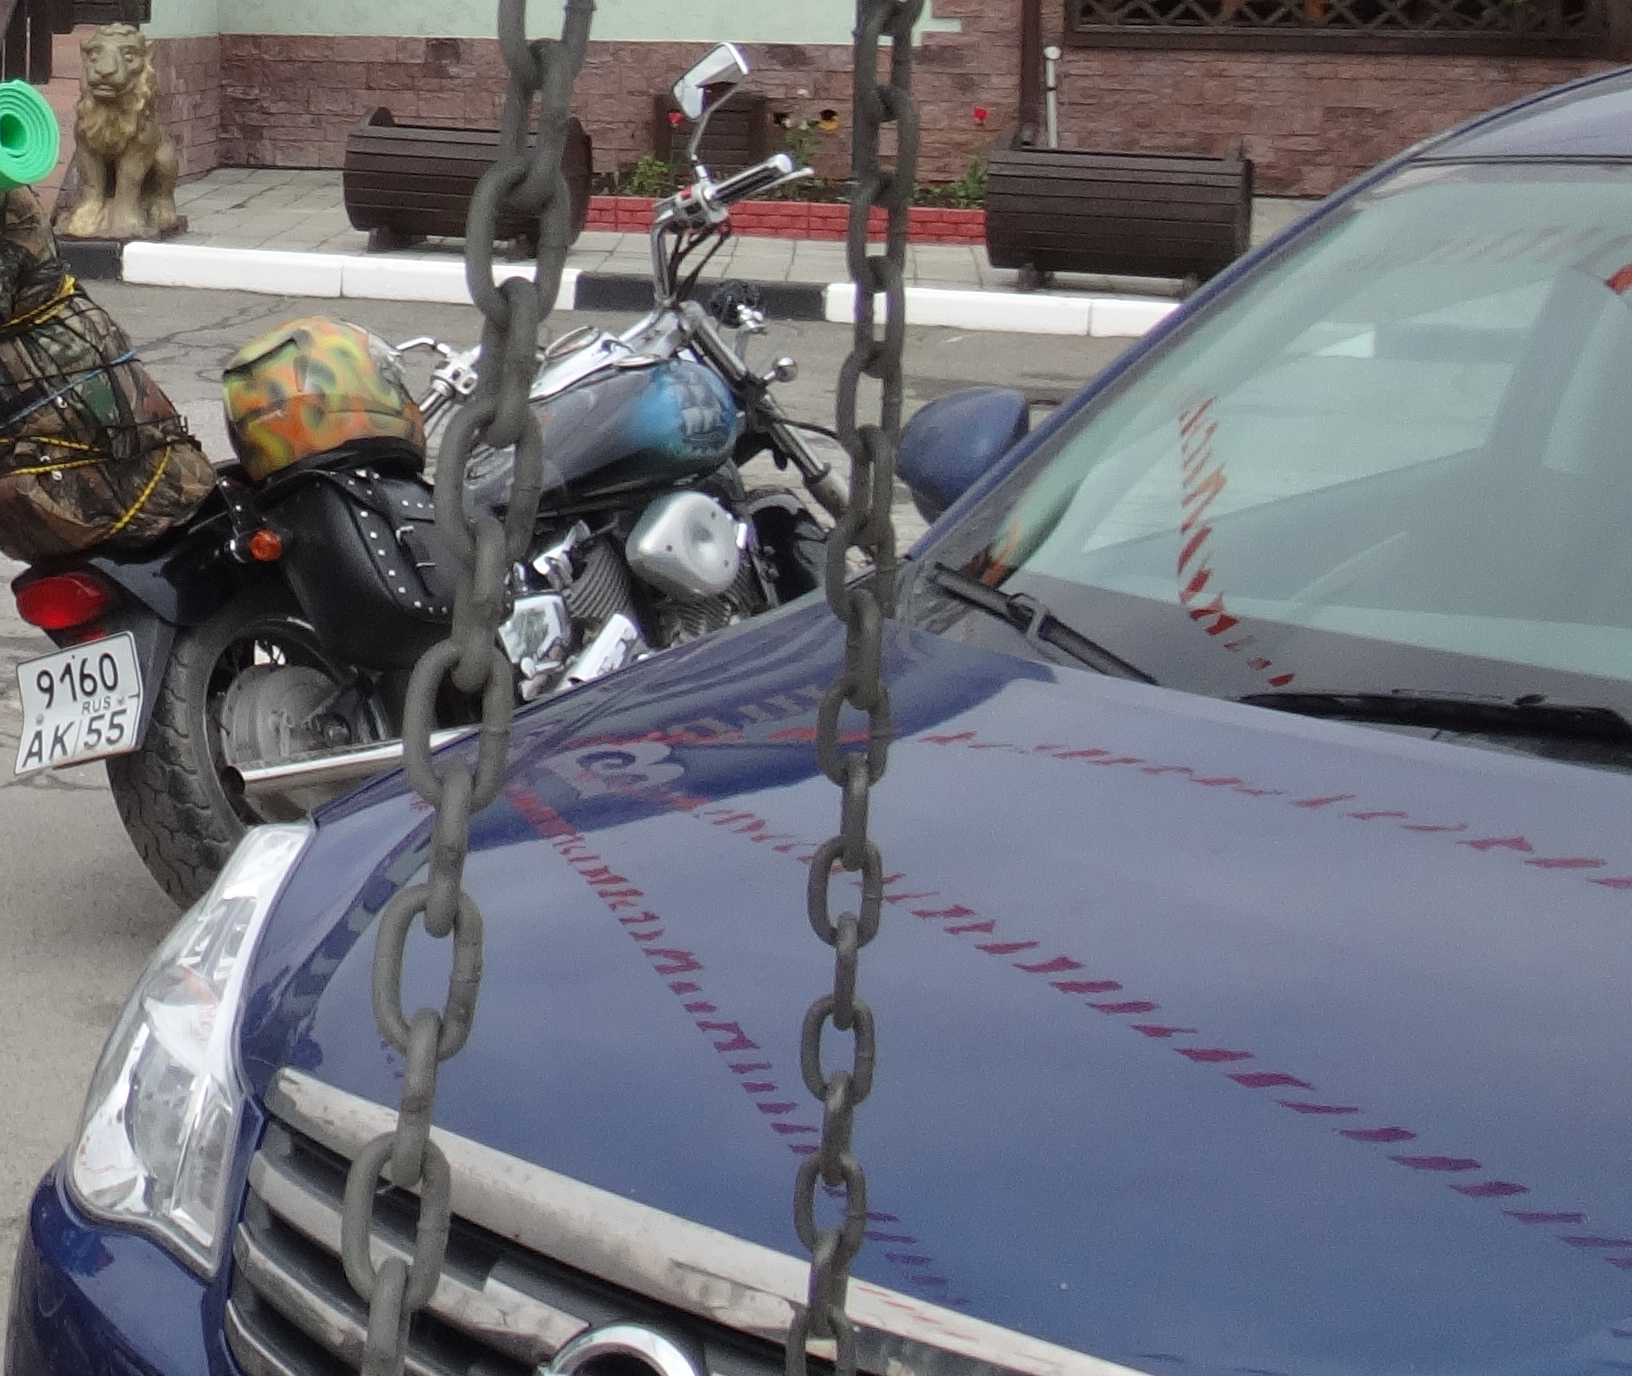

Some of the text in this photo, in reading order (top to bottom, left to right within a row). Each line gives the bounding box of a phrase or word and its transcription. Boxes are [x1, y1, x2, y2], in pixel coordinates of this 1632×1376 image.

[36, 652, 119, 709] 9160
[81, 695, 112, 715] RUS
[83, 709, 127, 752] 55
